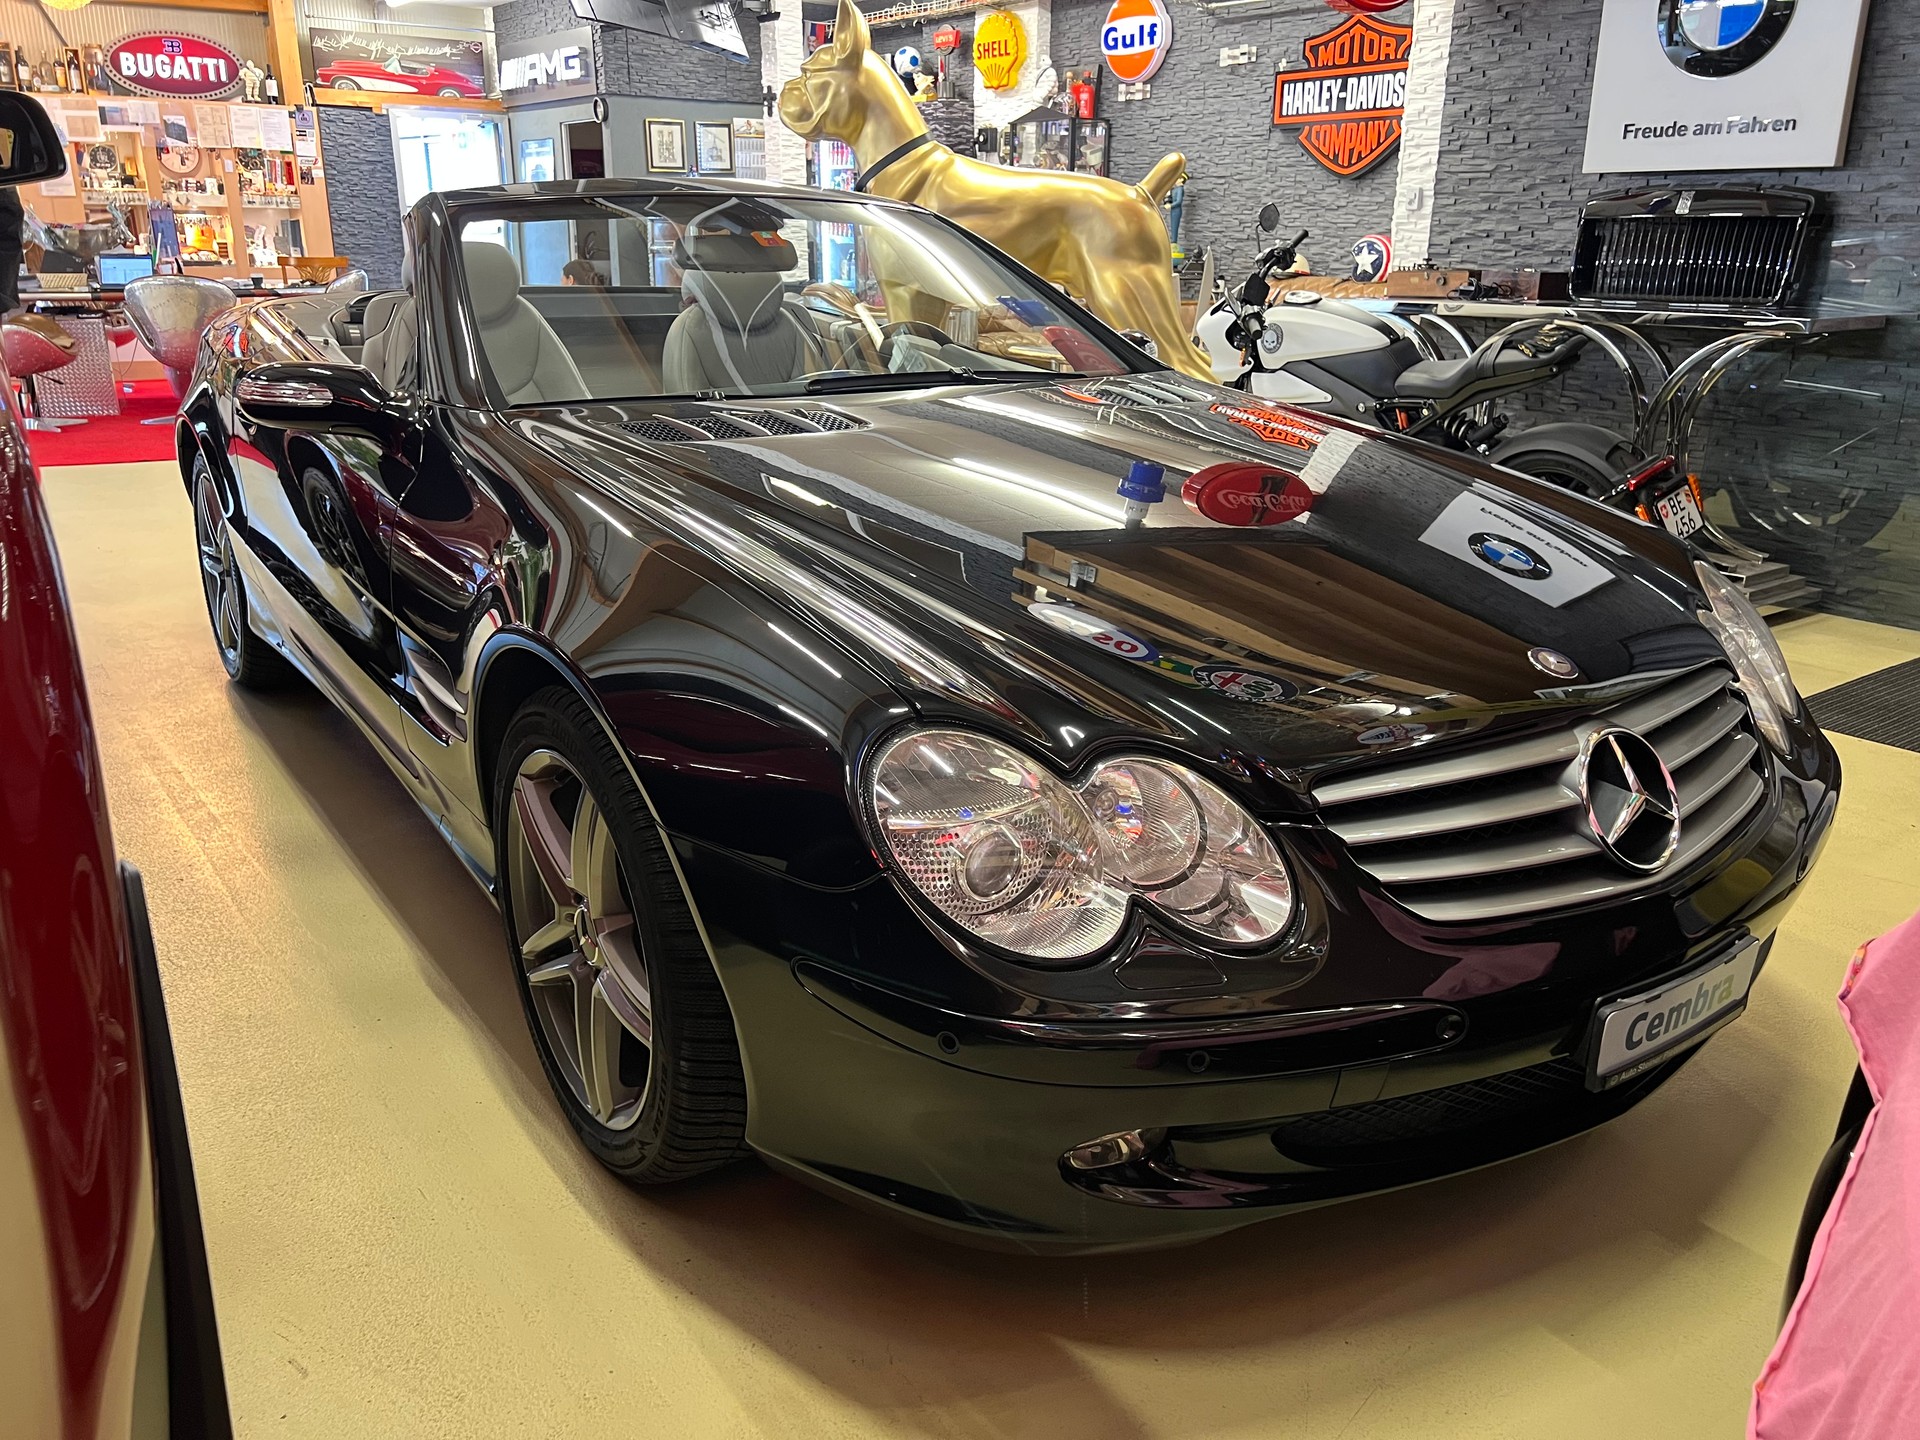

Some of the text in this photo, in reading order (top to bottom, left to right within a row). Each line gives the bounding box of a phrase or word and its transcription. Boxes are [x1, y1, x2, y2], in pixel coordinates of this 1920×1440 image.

[977, 39, 1011, 61] SHELL
[1103, 22, 1158, 51] Gulf
[1318, 23, 1397, 67] MOTOR
[119, 51, 228, 83] BUGATTI
[1282, 71, 1406, 116] HARLEY-DAVIDS
[1311, 119, 1391, 167] COMPANY
[1622, 116, 1797, 140] Freude am Fahren
[1667, 491, 1686, 517] BE
[1675, 512, 1696, 538] 456
[1624, 974, 1735, 1051] Cembra
